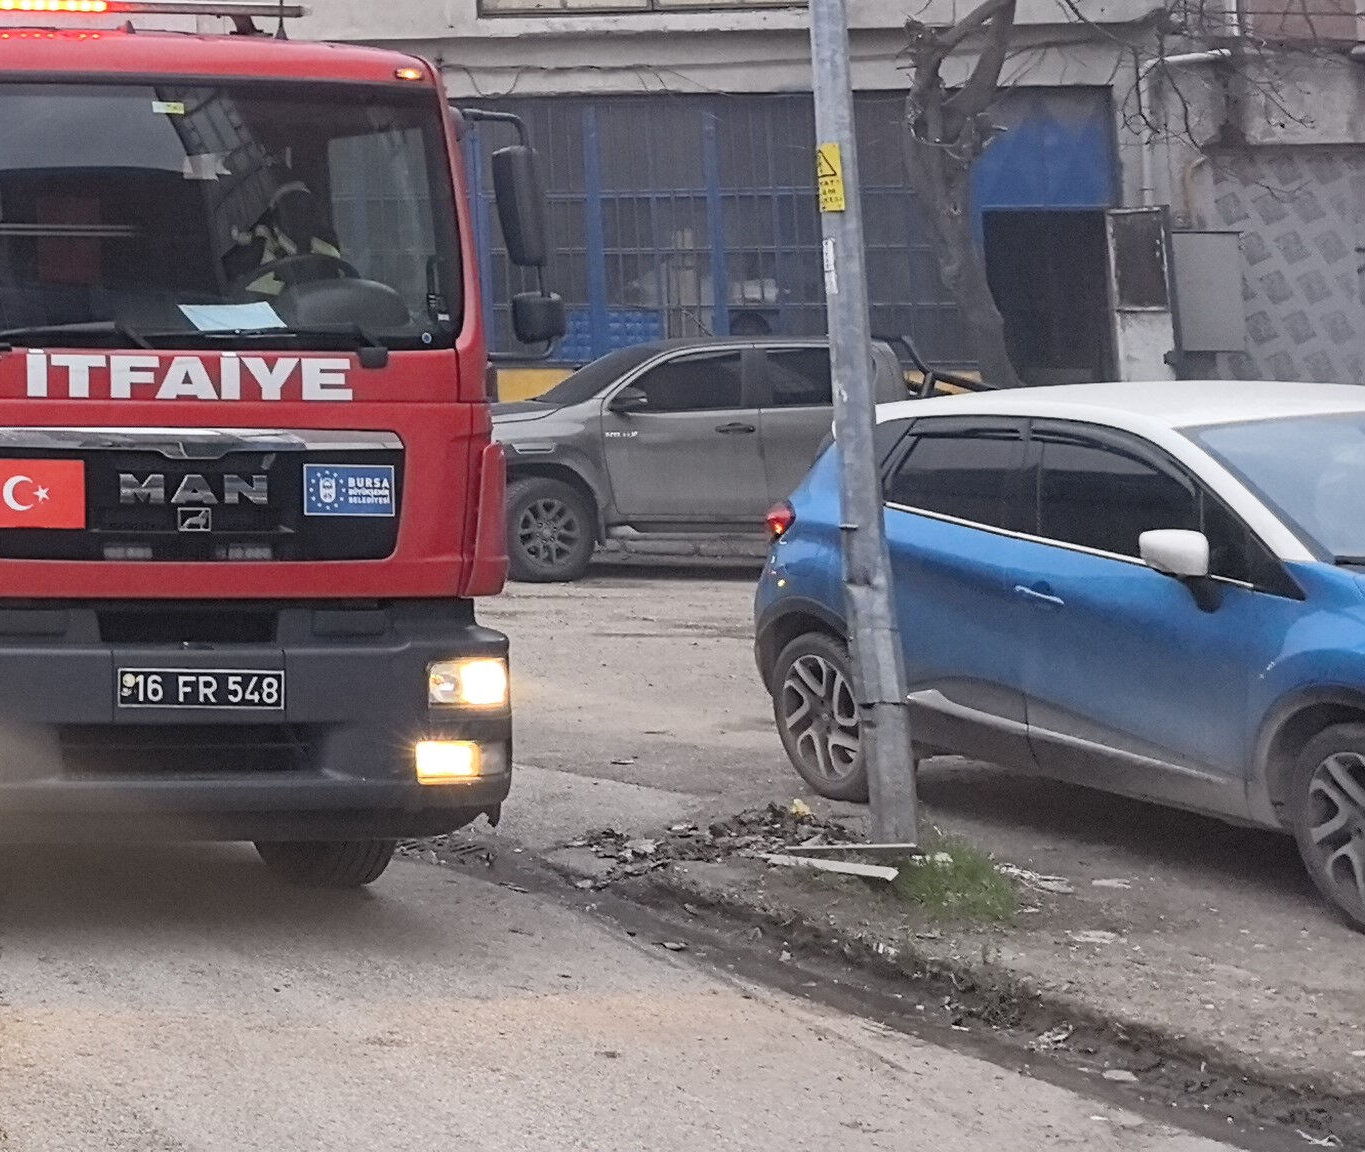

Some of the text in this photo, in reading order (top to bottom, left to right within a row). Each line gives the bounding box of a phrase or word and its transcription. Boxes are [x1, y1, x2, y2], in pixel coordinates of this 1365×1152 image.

[26, 348, 353, 401] İTFAİYE
[118, 472, 268, 505] MAN
[348, 476, 389, 488] BURSA
[135, 673, 278, 704] 16 FR 548
